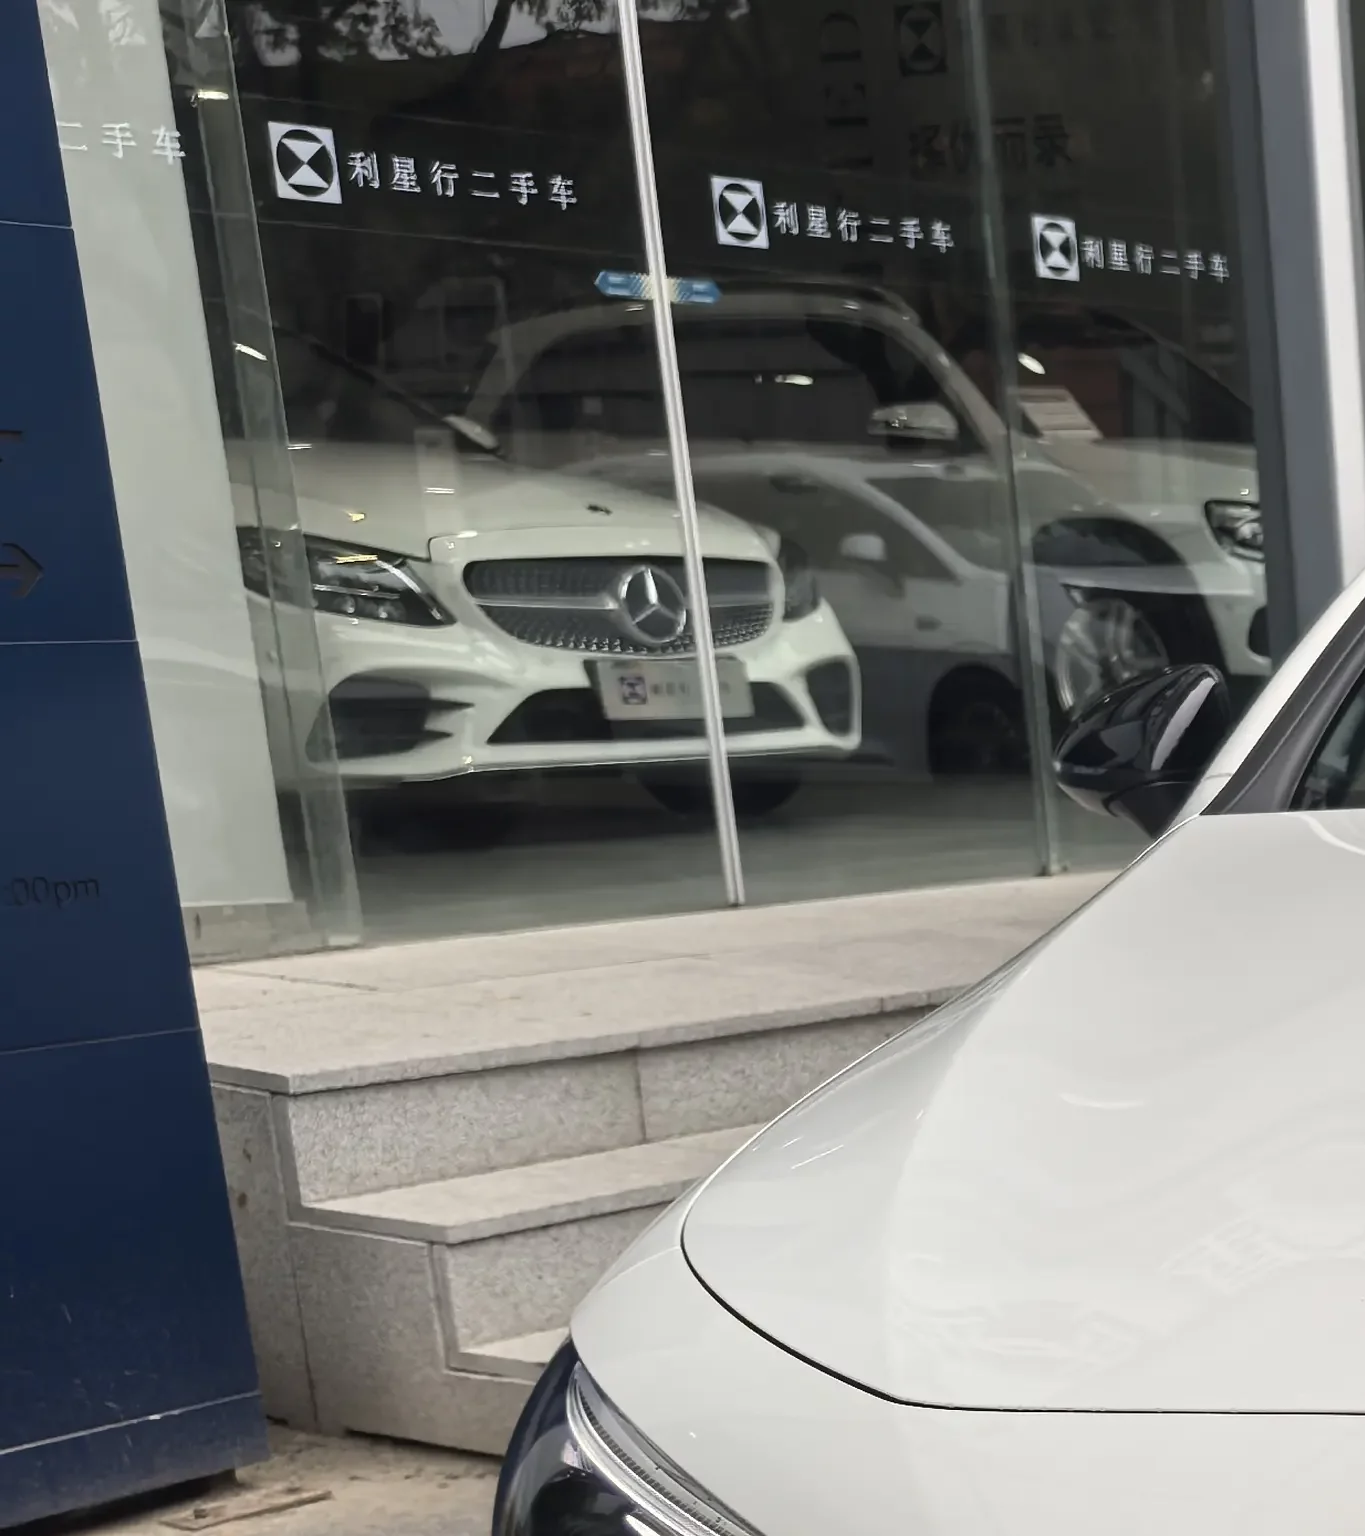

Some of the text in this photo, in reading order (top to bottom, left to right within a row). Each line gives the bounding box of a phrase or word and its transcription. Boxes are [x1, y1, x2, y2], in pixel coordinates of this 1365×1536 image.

[57, 121, 187, 165] 二手车
[347, 150, 578, 211] 利星行二手车
[773, 201, 955, 253] 利星行二手车
[1080, 237, 1230, 284] 利星行二手车
